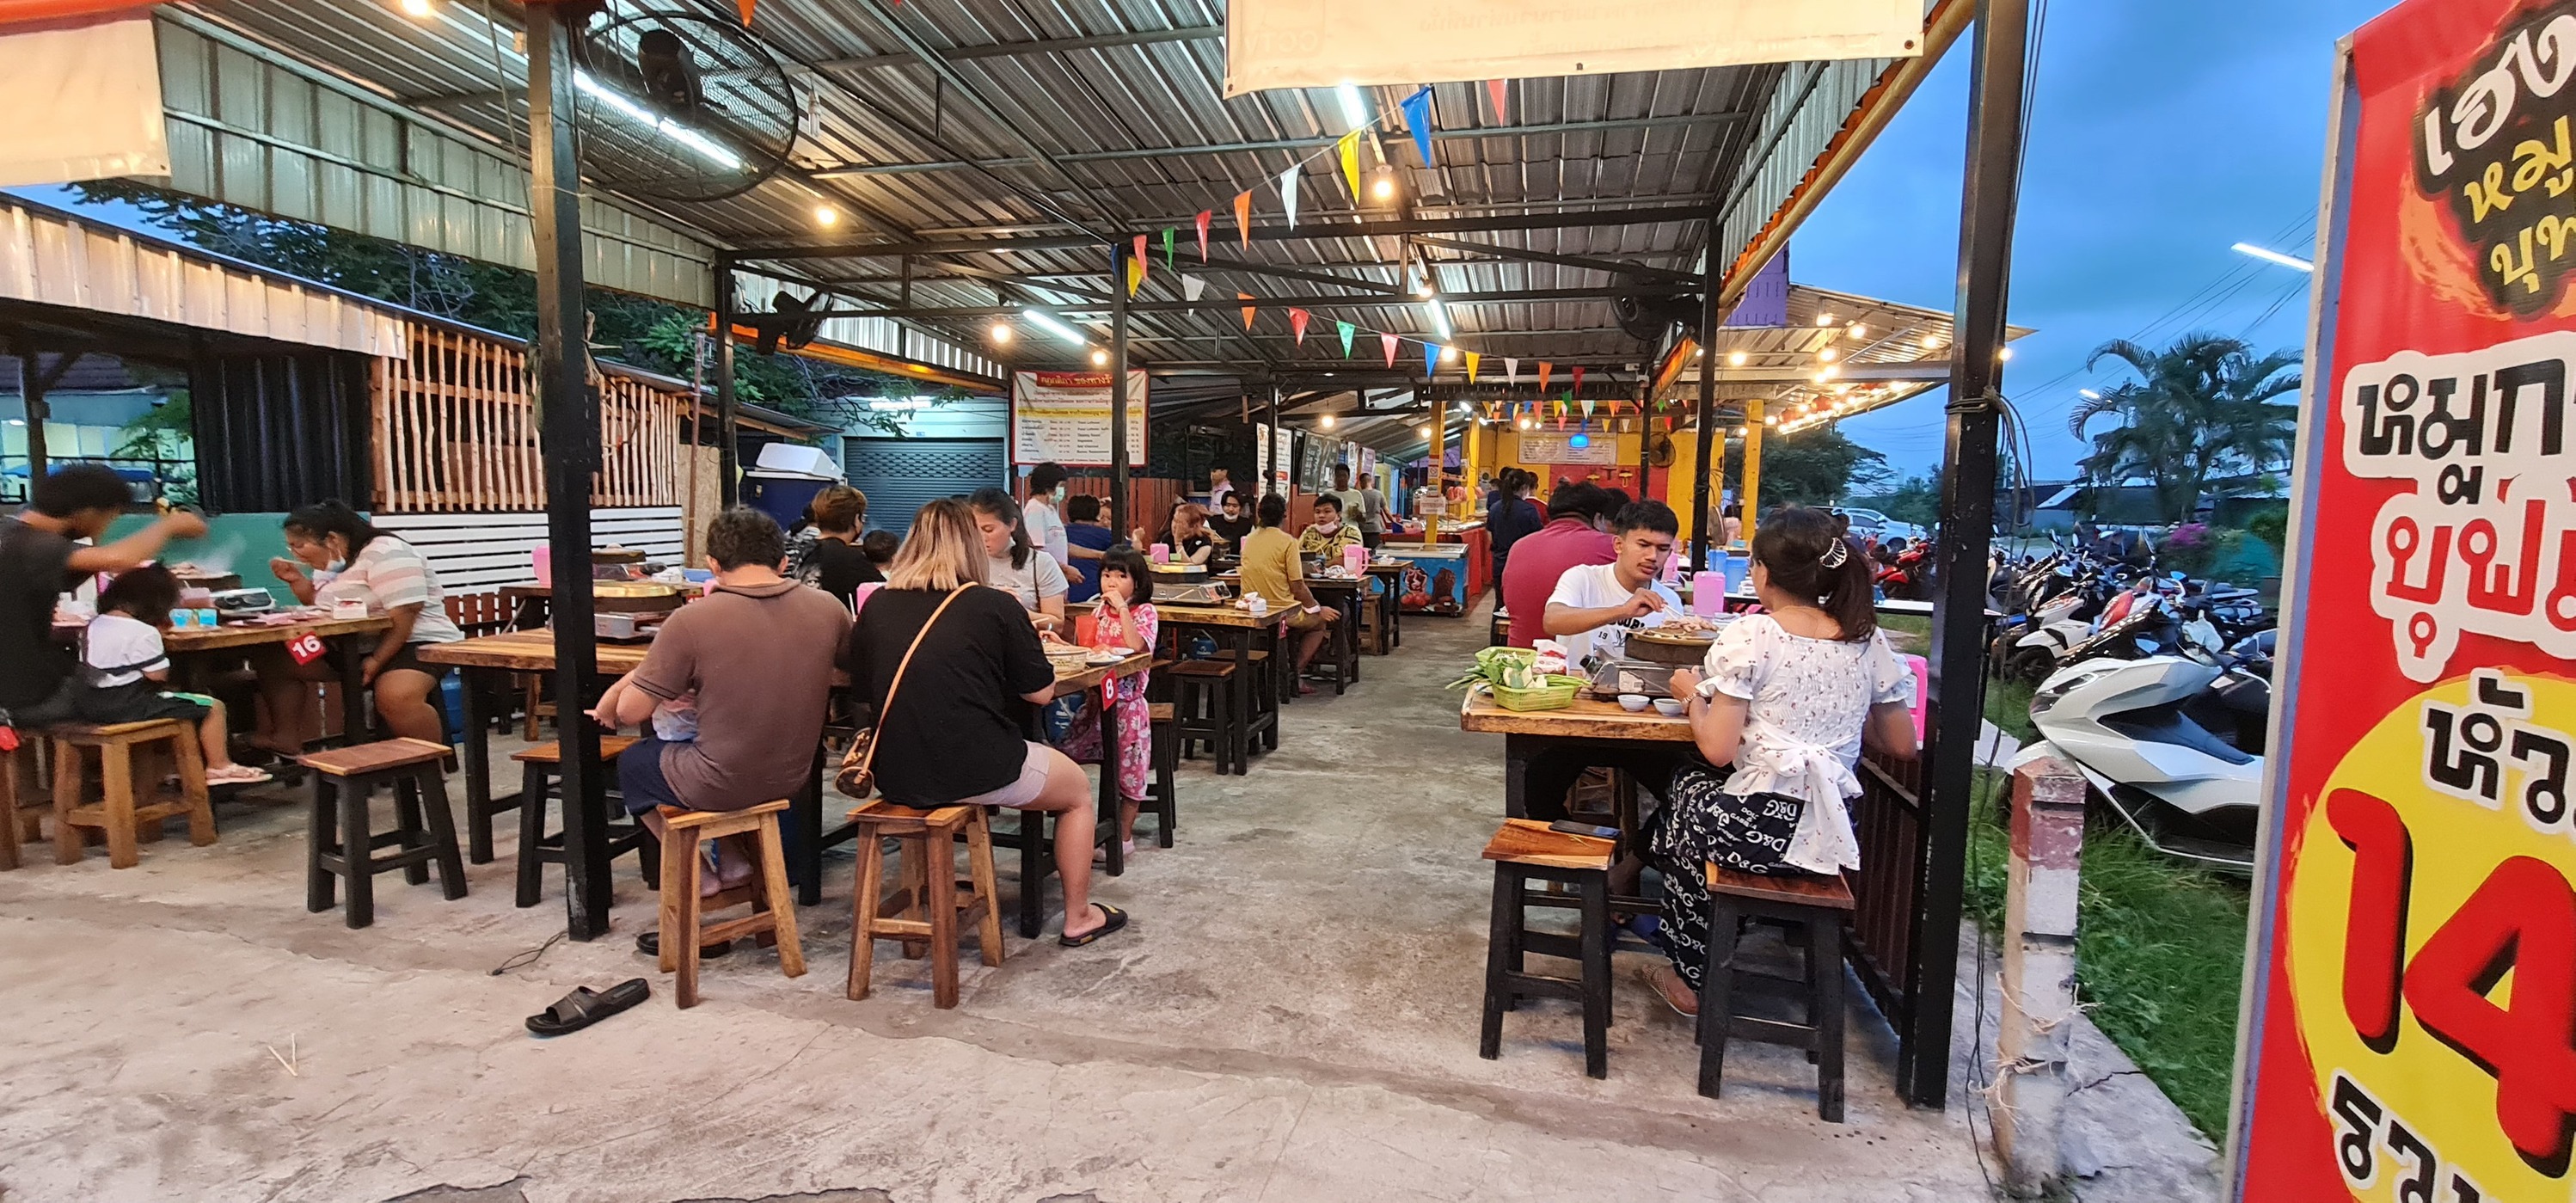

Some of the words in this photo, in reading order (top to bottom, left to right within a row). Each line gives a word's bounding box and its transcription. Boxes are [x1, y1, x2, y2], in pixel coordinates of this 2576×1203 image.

[2357, 359, 2576, 505] หมูก
[292, 635, 321, 658] 16
[1598, 631, 1608, 640] 19
[1106, 678, 1114, 699] 8
[2426, 677, 2576, 829] หัว
[1745, 830, 1787, 852] D&G
[1727, 850, 1769, 874] D&G
